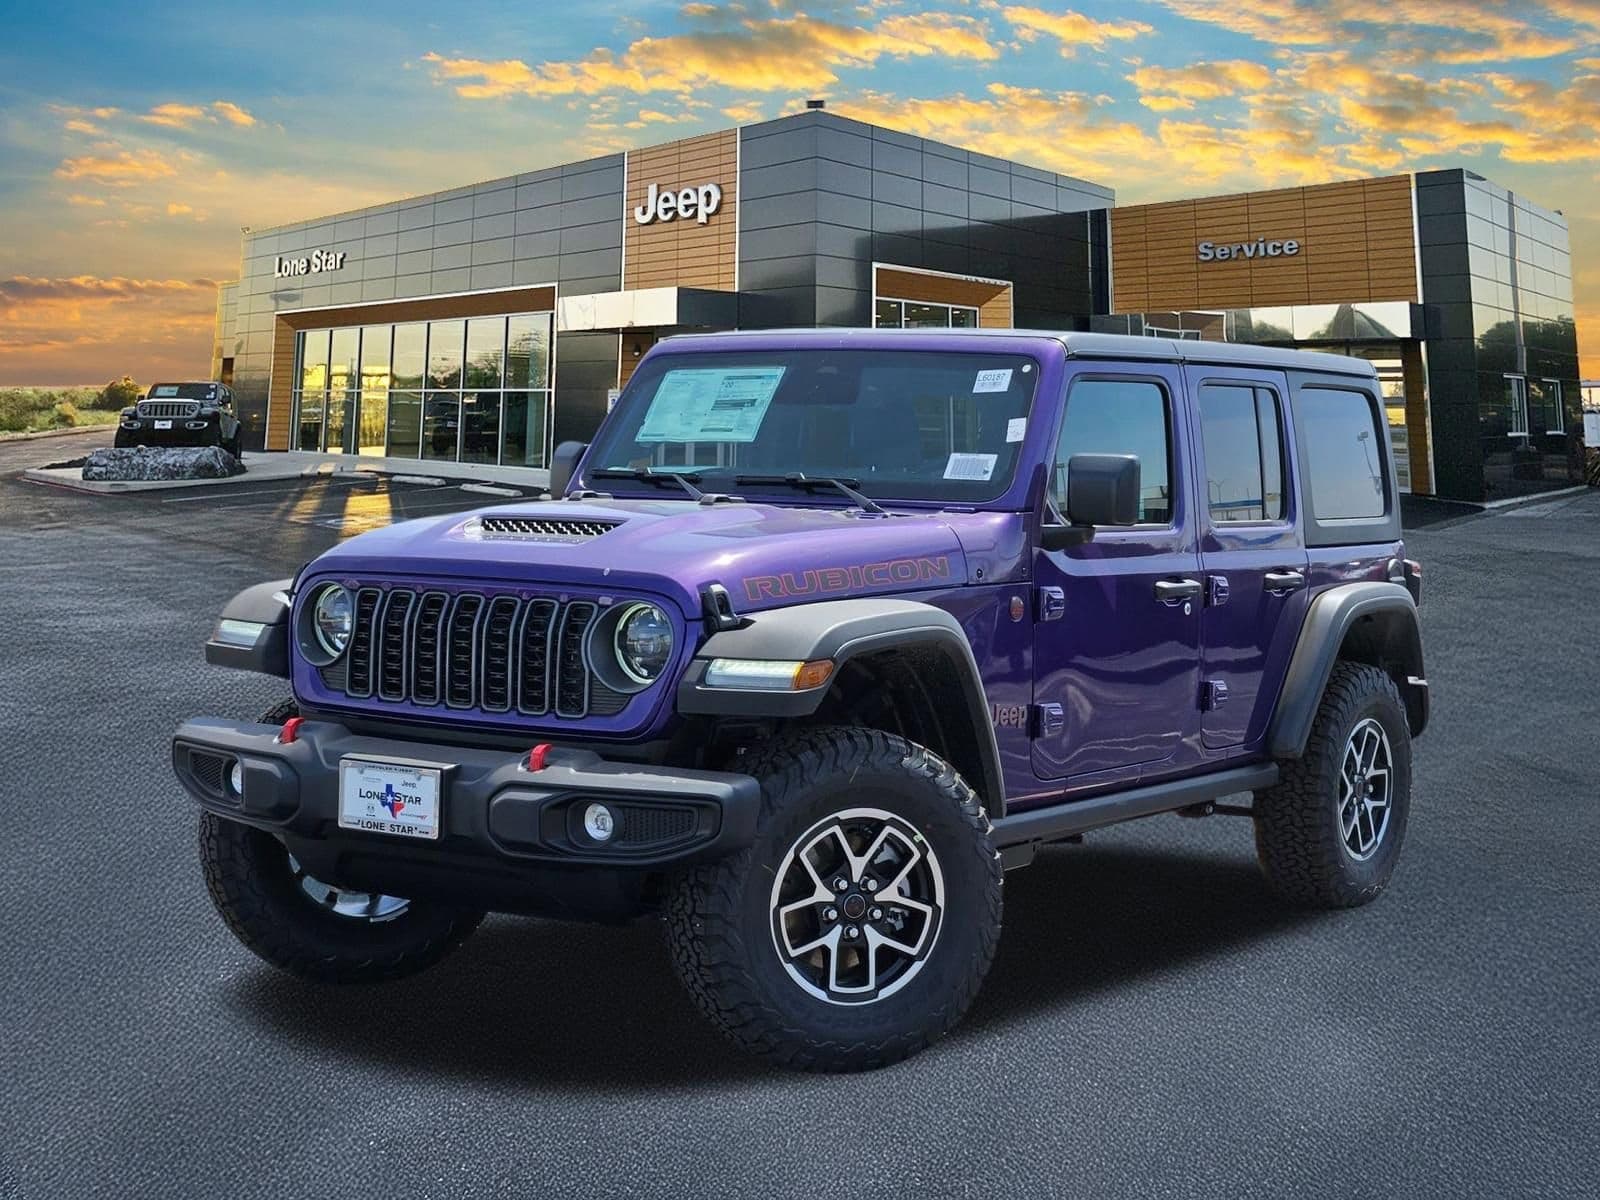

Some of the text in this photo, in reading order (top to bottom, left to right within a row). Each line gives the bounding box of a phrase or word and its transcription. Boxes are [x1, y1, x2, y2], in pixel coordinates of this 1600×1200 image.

[634, 183, 722, 225] Jeep
[1198, 235, 1299, 261] Service
[275, 249, 346, 278] Lone Star
[743, 556, 950, 601] RUBICON
[991, 703, 1028, 729] Jeep
[359, 788, 422, 806] LONE STAR
